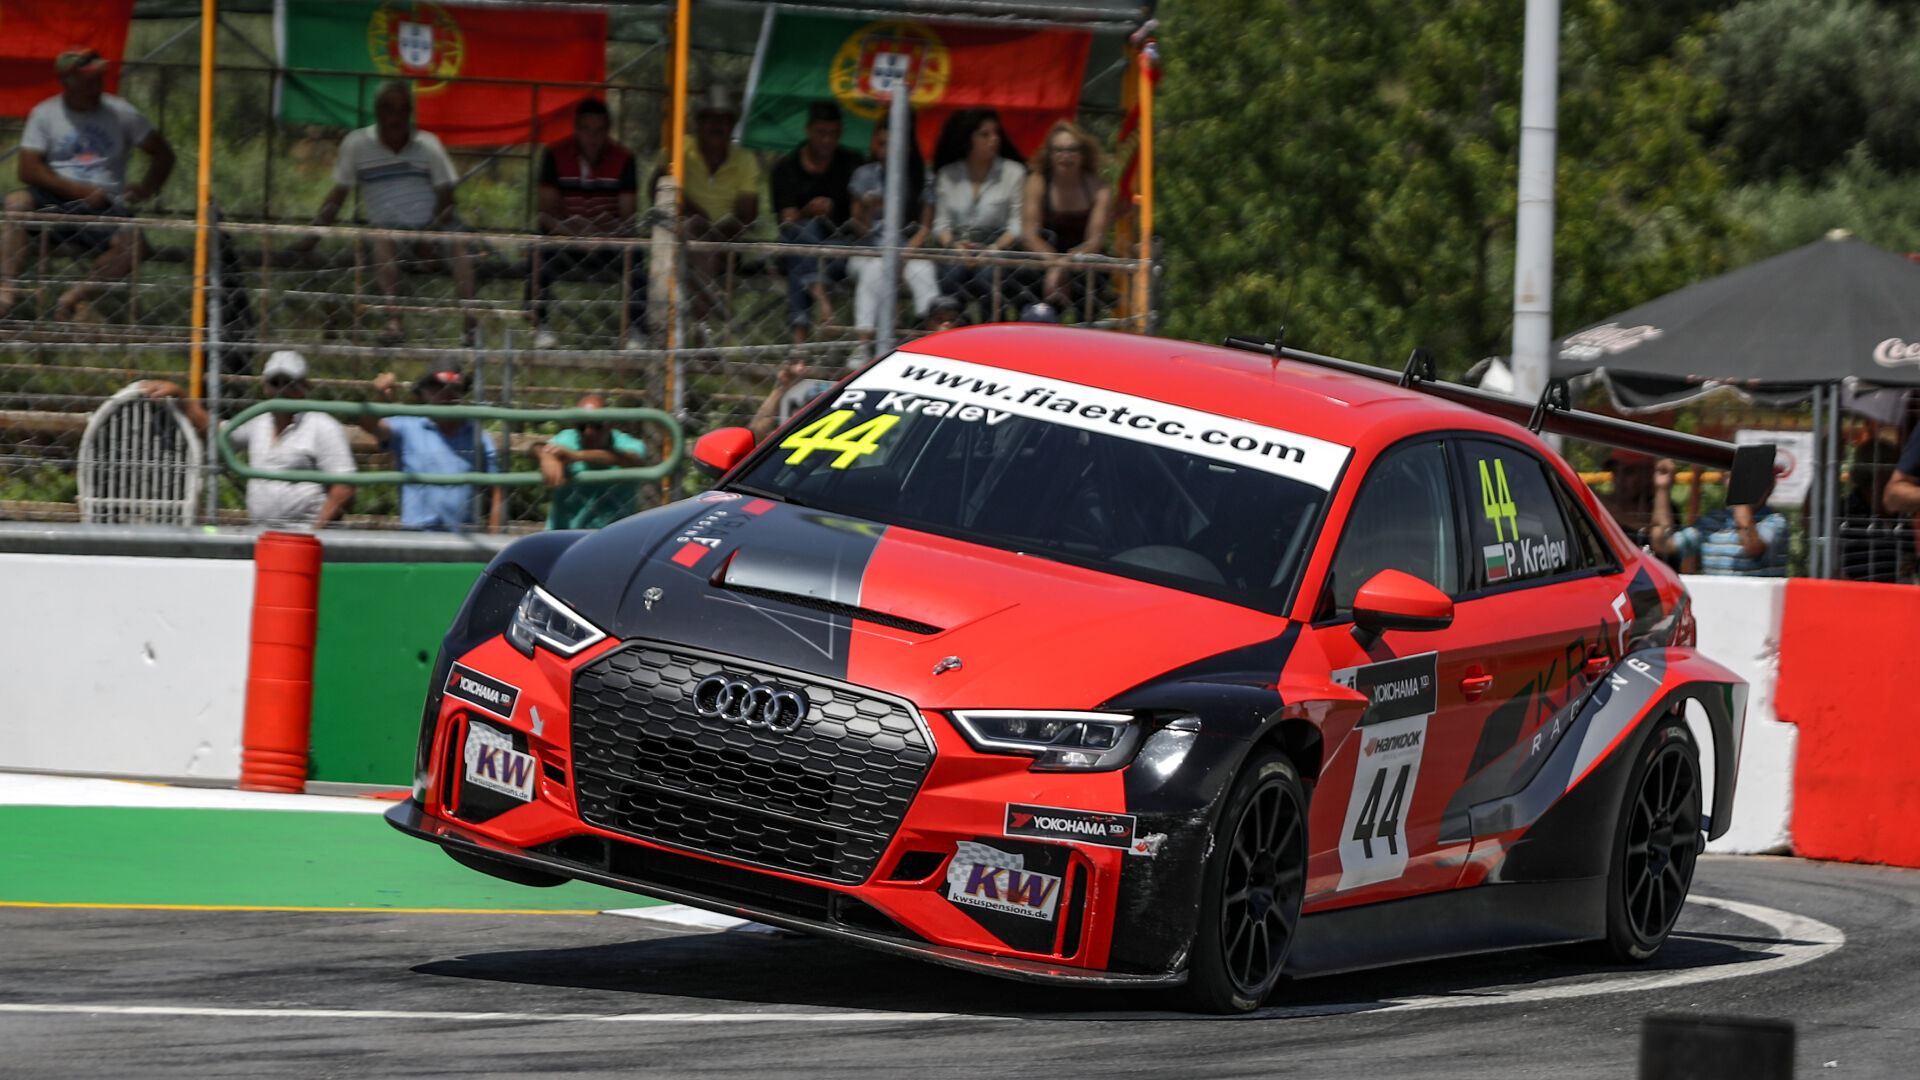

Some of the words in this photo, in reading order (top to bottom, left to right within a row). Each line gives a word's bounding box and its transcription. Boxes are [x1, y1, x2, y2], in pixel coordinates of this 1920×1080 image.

[831, 390, 867, 410] P.
[875, 391, 1013, 426] Kralev
[900, 364, 1305, 464] www.fiaetcc.com
[779, 409, 901, 470] 44
[1479, 458, 1519, 542] 44
[1504, 542, 1521, 577] P.
[1520, 534, 1566, 574] Kralev
[460, 676, 501, 704] YOKOHAMA
[1373, 677, 1419, 702] YOKOHAMA
[476, 743, 534, 790] KW
[1033, 815, 1107, 836] YOKOHAMA
[1352, 764, 1411, 859] 44
[952, 892, 1048, 919] kwsuspensions.de
[964, 862, 1059, 910] KW
